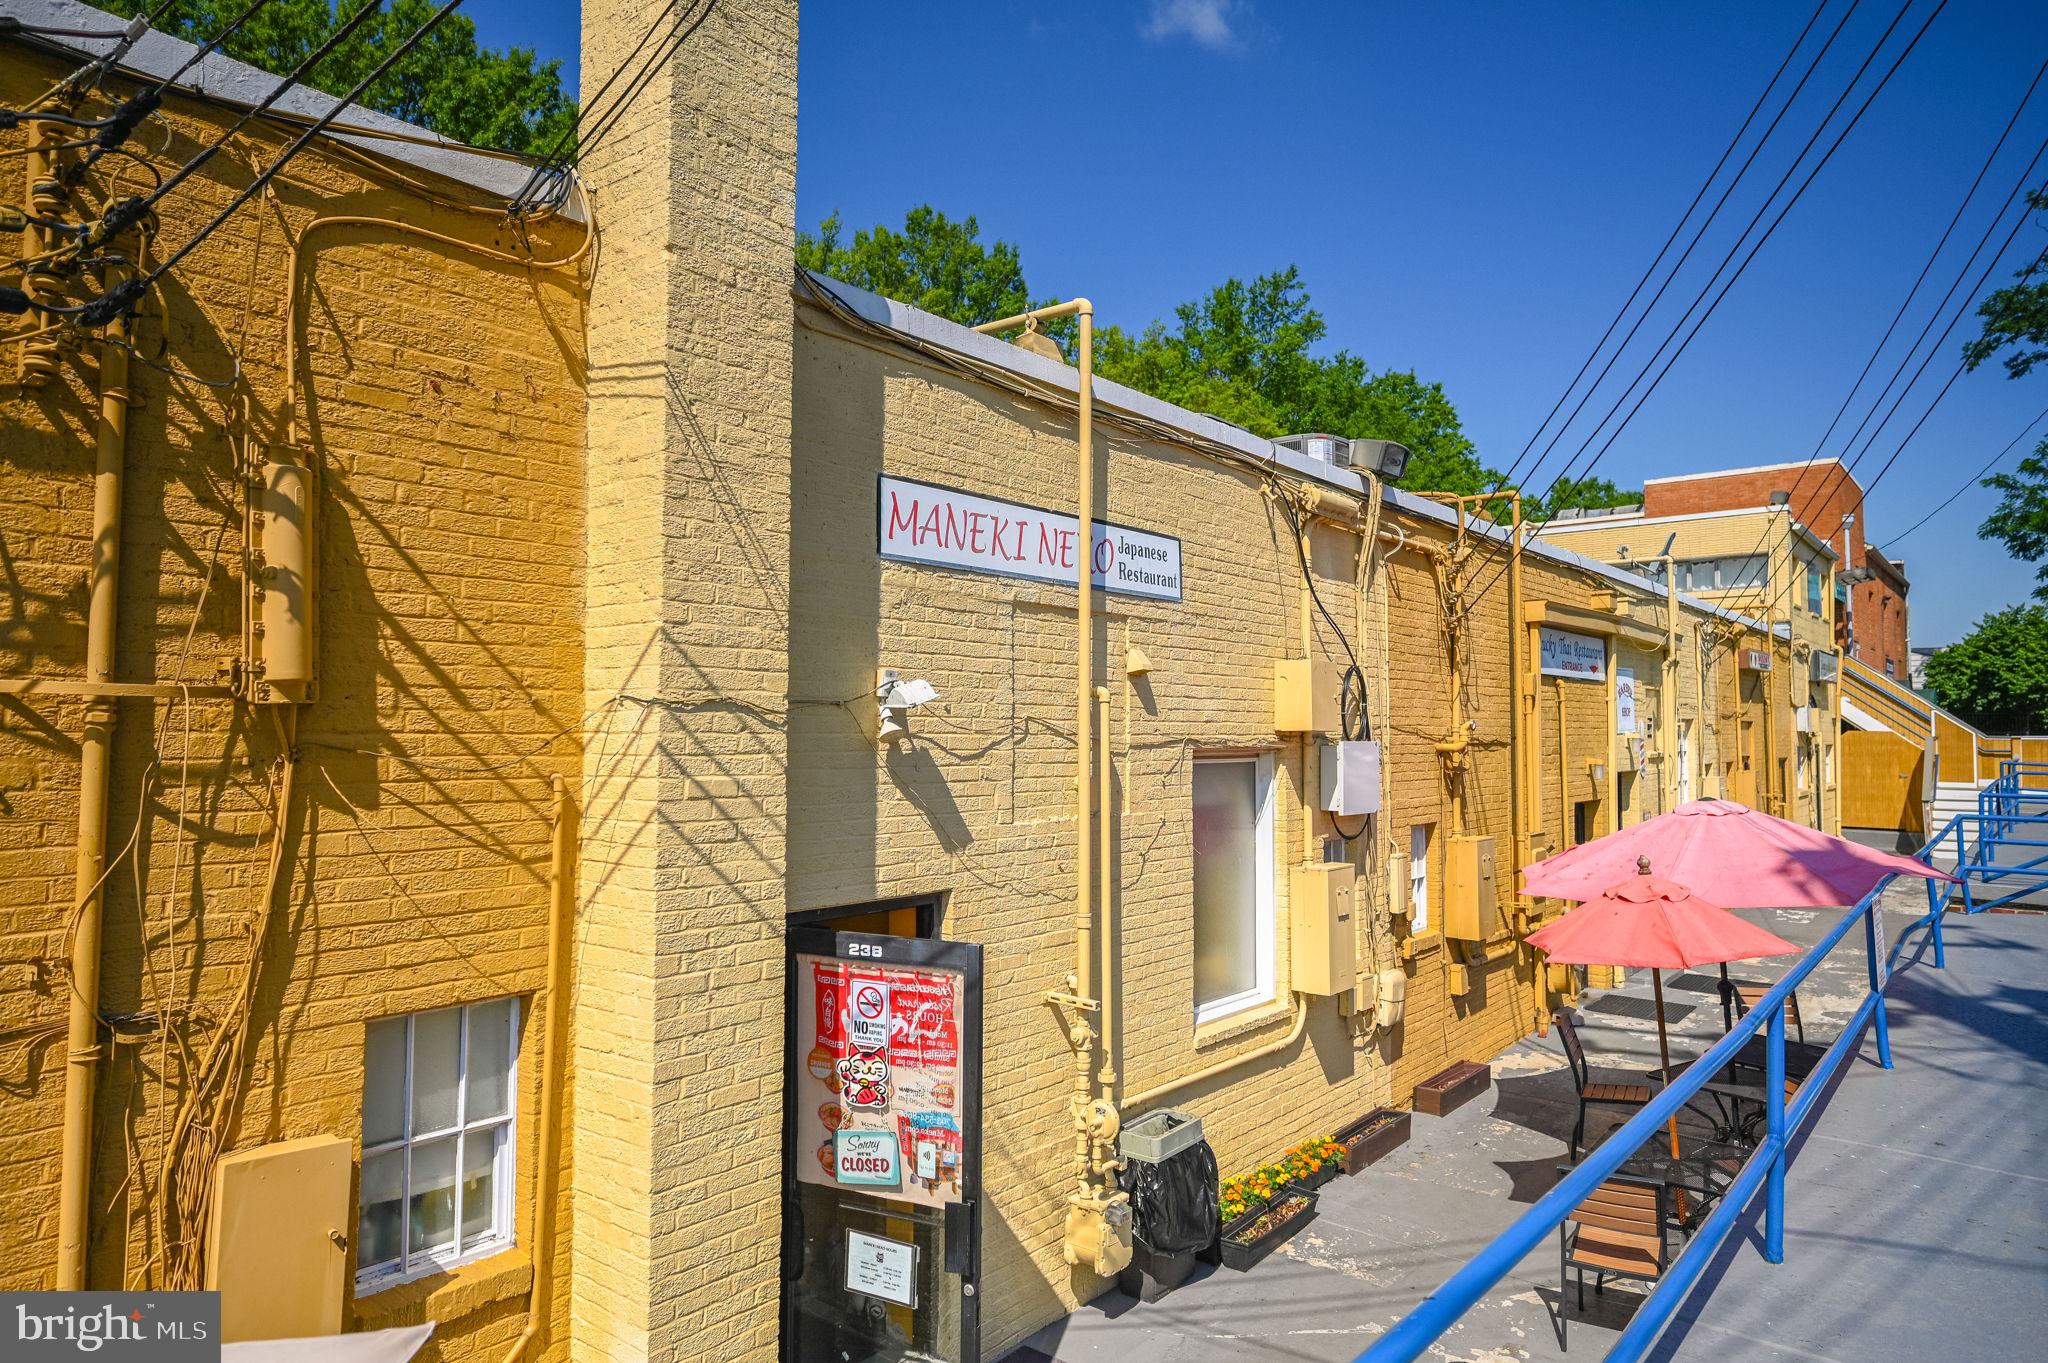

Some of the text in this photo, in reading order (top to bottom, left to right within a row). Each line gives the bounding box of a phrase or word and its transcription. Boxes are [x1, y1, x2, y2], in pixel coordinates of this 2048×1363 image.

[888, 491, 1115, 575] MANEKI NEO
[1117, 535, 1168, 563] Japanese
[1118, 561, 1178, 589] Restaurant
[1541, 634, 1557, 659] ucky
[1559, 636, 1572, 656] Thai
[1561, 661, 1583, 672] ENTRANCE
[848, 943, 883, 958] 238
[854, 1020, 869, 1035] NO
[846, 1134, 881, 1153] Sorry
[841, 1157, 890, 1173] CLOSED
